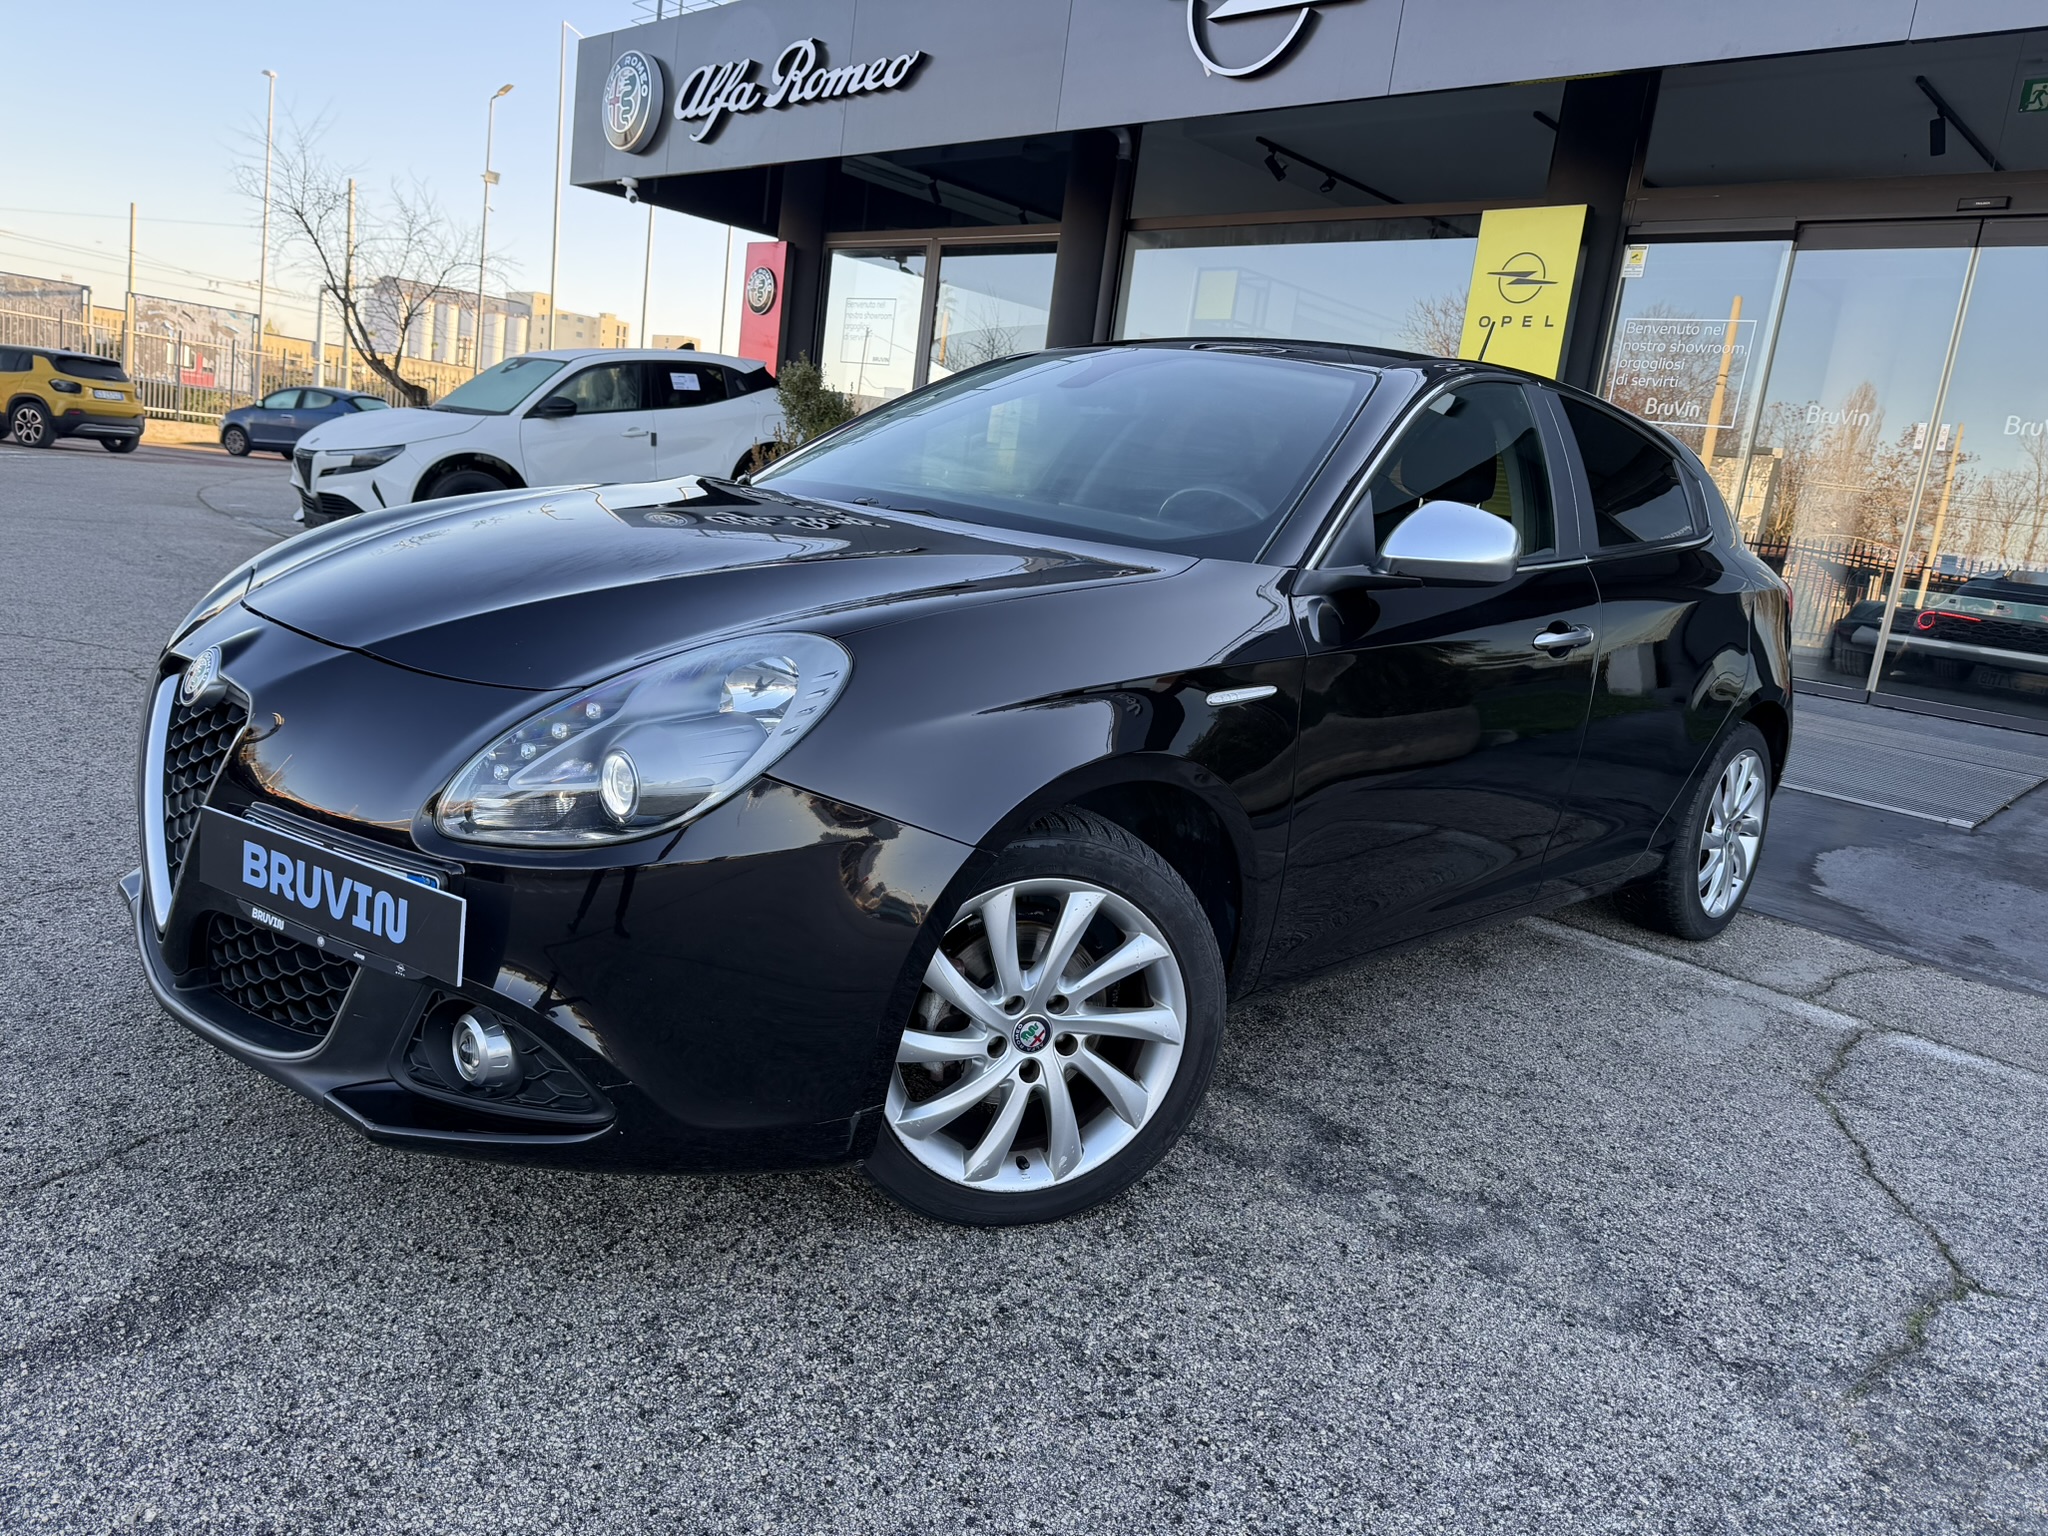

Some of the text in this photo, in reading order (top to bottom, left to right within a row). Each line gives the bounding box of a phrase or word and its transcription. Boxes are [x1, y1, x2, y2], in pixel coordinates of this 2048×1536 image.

[624, 55, 649, 97] ROMEO
[673, 37, 923, 142] Alfa Romeo
[1478, 315, 1554, 328] OPEL
[1626, 322, 1726, 336] Benvenuto nel
[1622, 340, 1748, 356] nostro showroom,
[1619, 358, 1686, 371] orgogliosi
[1615, 374, 1680, 387] di servirti
[1644, 397, 1701, 417] BruVin
[1806, 405, 1870, 426] BruVin
[2003, 414, 2048, 437] Bru
[242, 839, 409, 944] BRUVIN
[251, 907, 285, 931] BRUVIN
[1015, 1023, 1025, 1050] ROMEO
